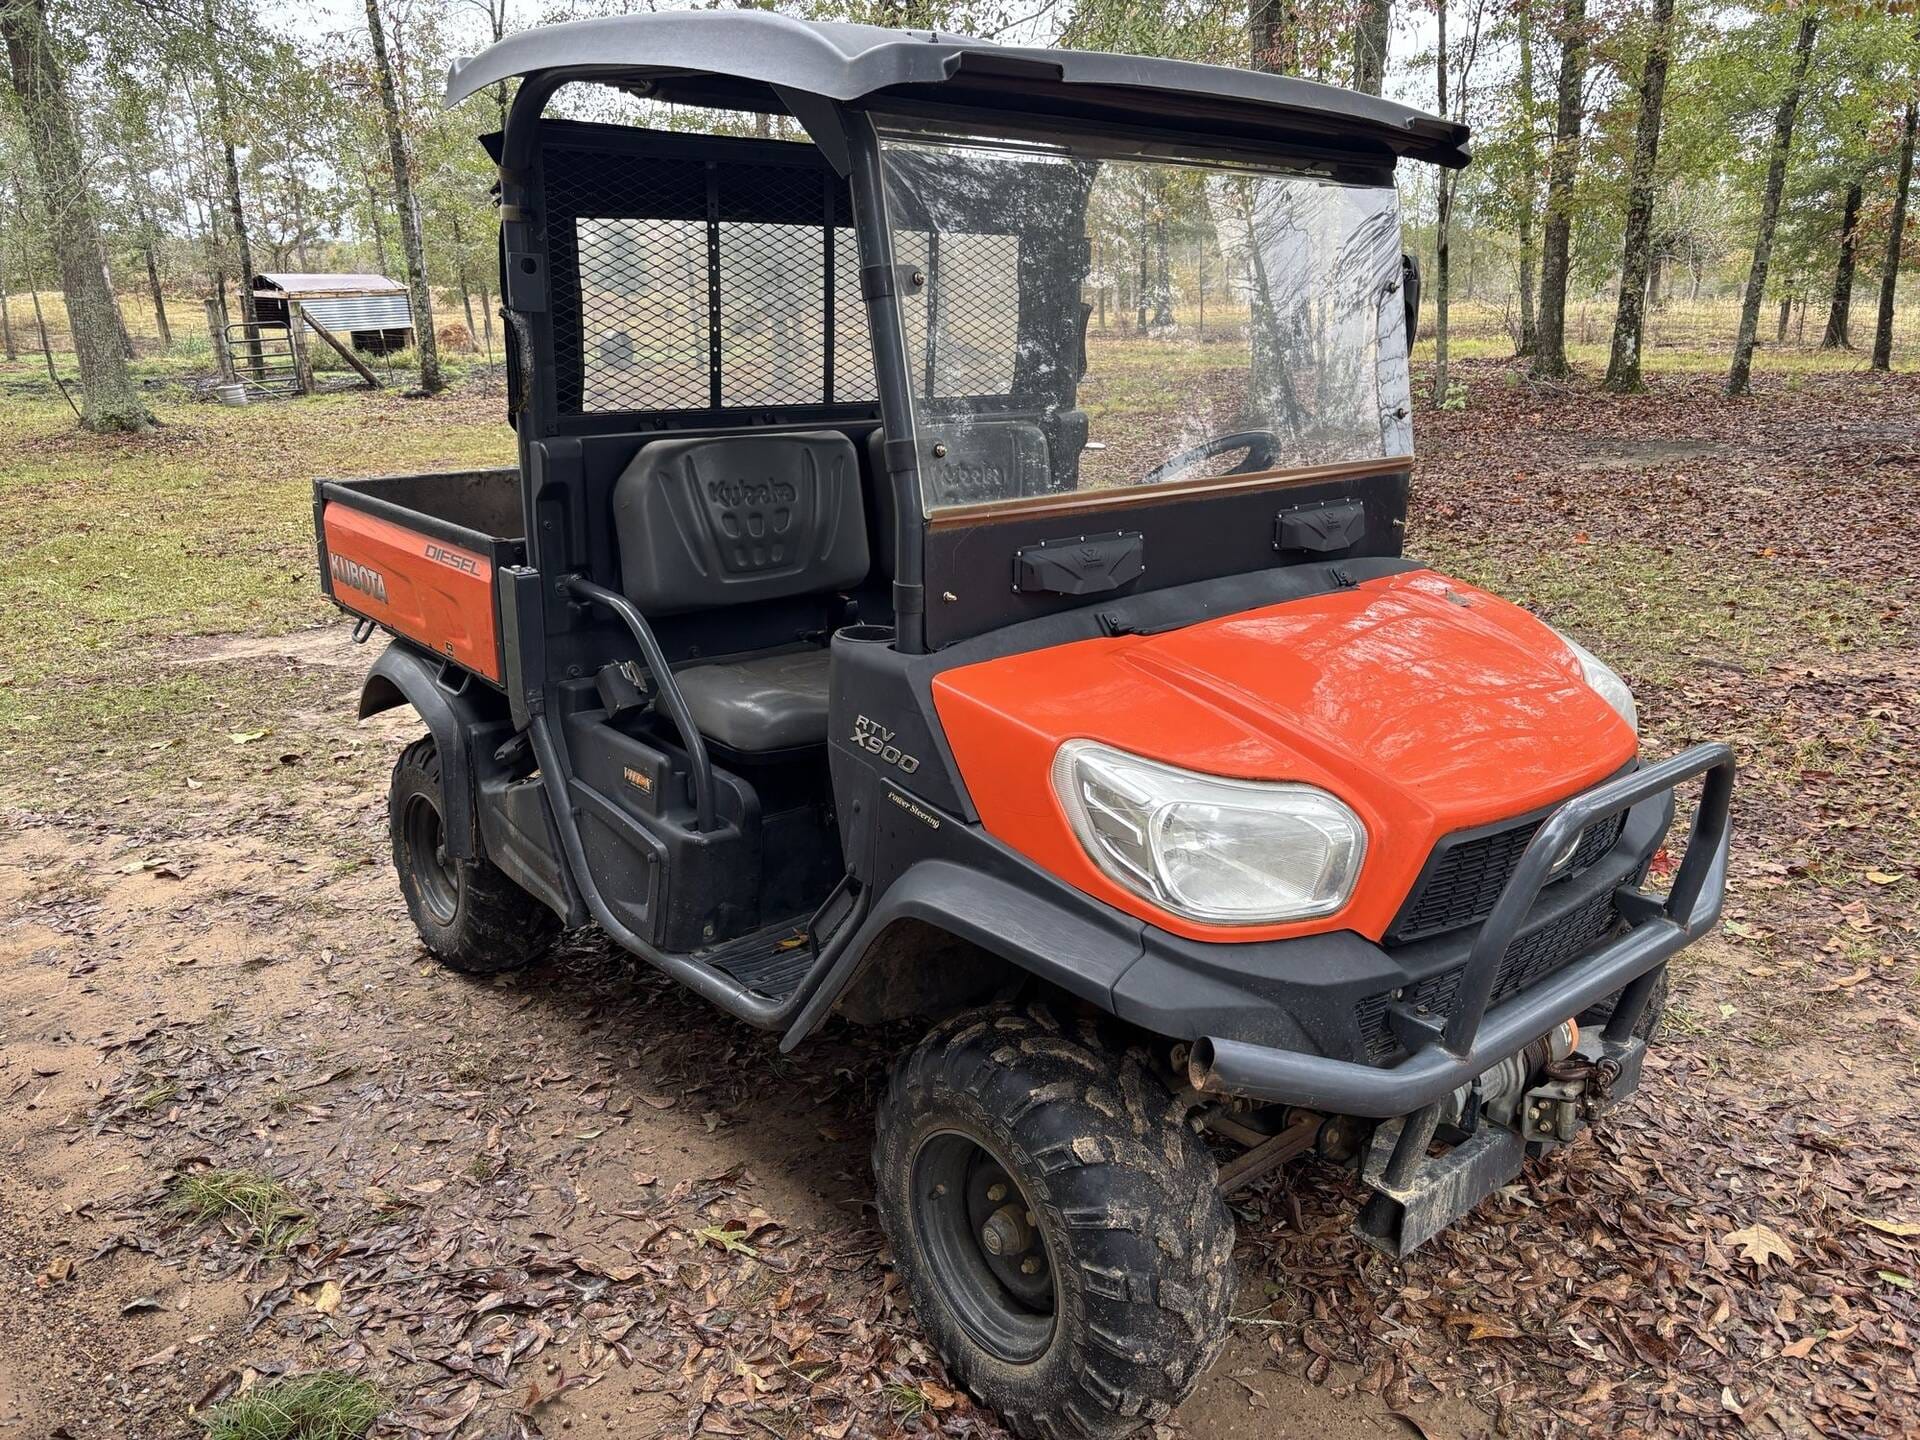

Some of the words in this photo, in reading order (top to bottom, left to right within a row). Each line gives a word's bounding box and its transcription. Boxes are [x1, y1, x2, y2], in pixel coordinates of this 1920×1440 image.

[707, 477, 799, 508] Kubota
[425, 544, 481, 576] DIESEL
[330, 552, 389, 605] KUBOTA
[856, 714, 896, 741] RTV
[849, 727, 920, 774] X900
[888, 791, 910, 809] Power
[910, 804, 940, 829] Steering
